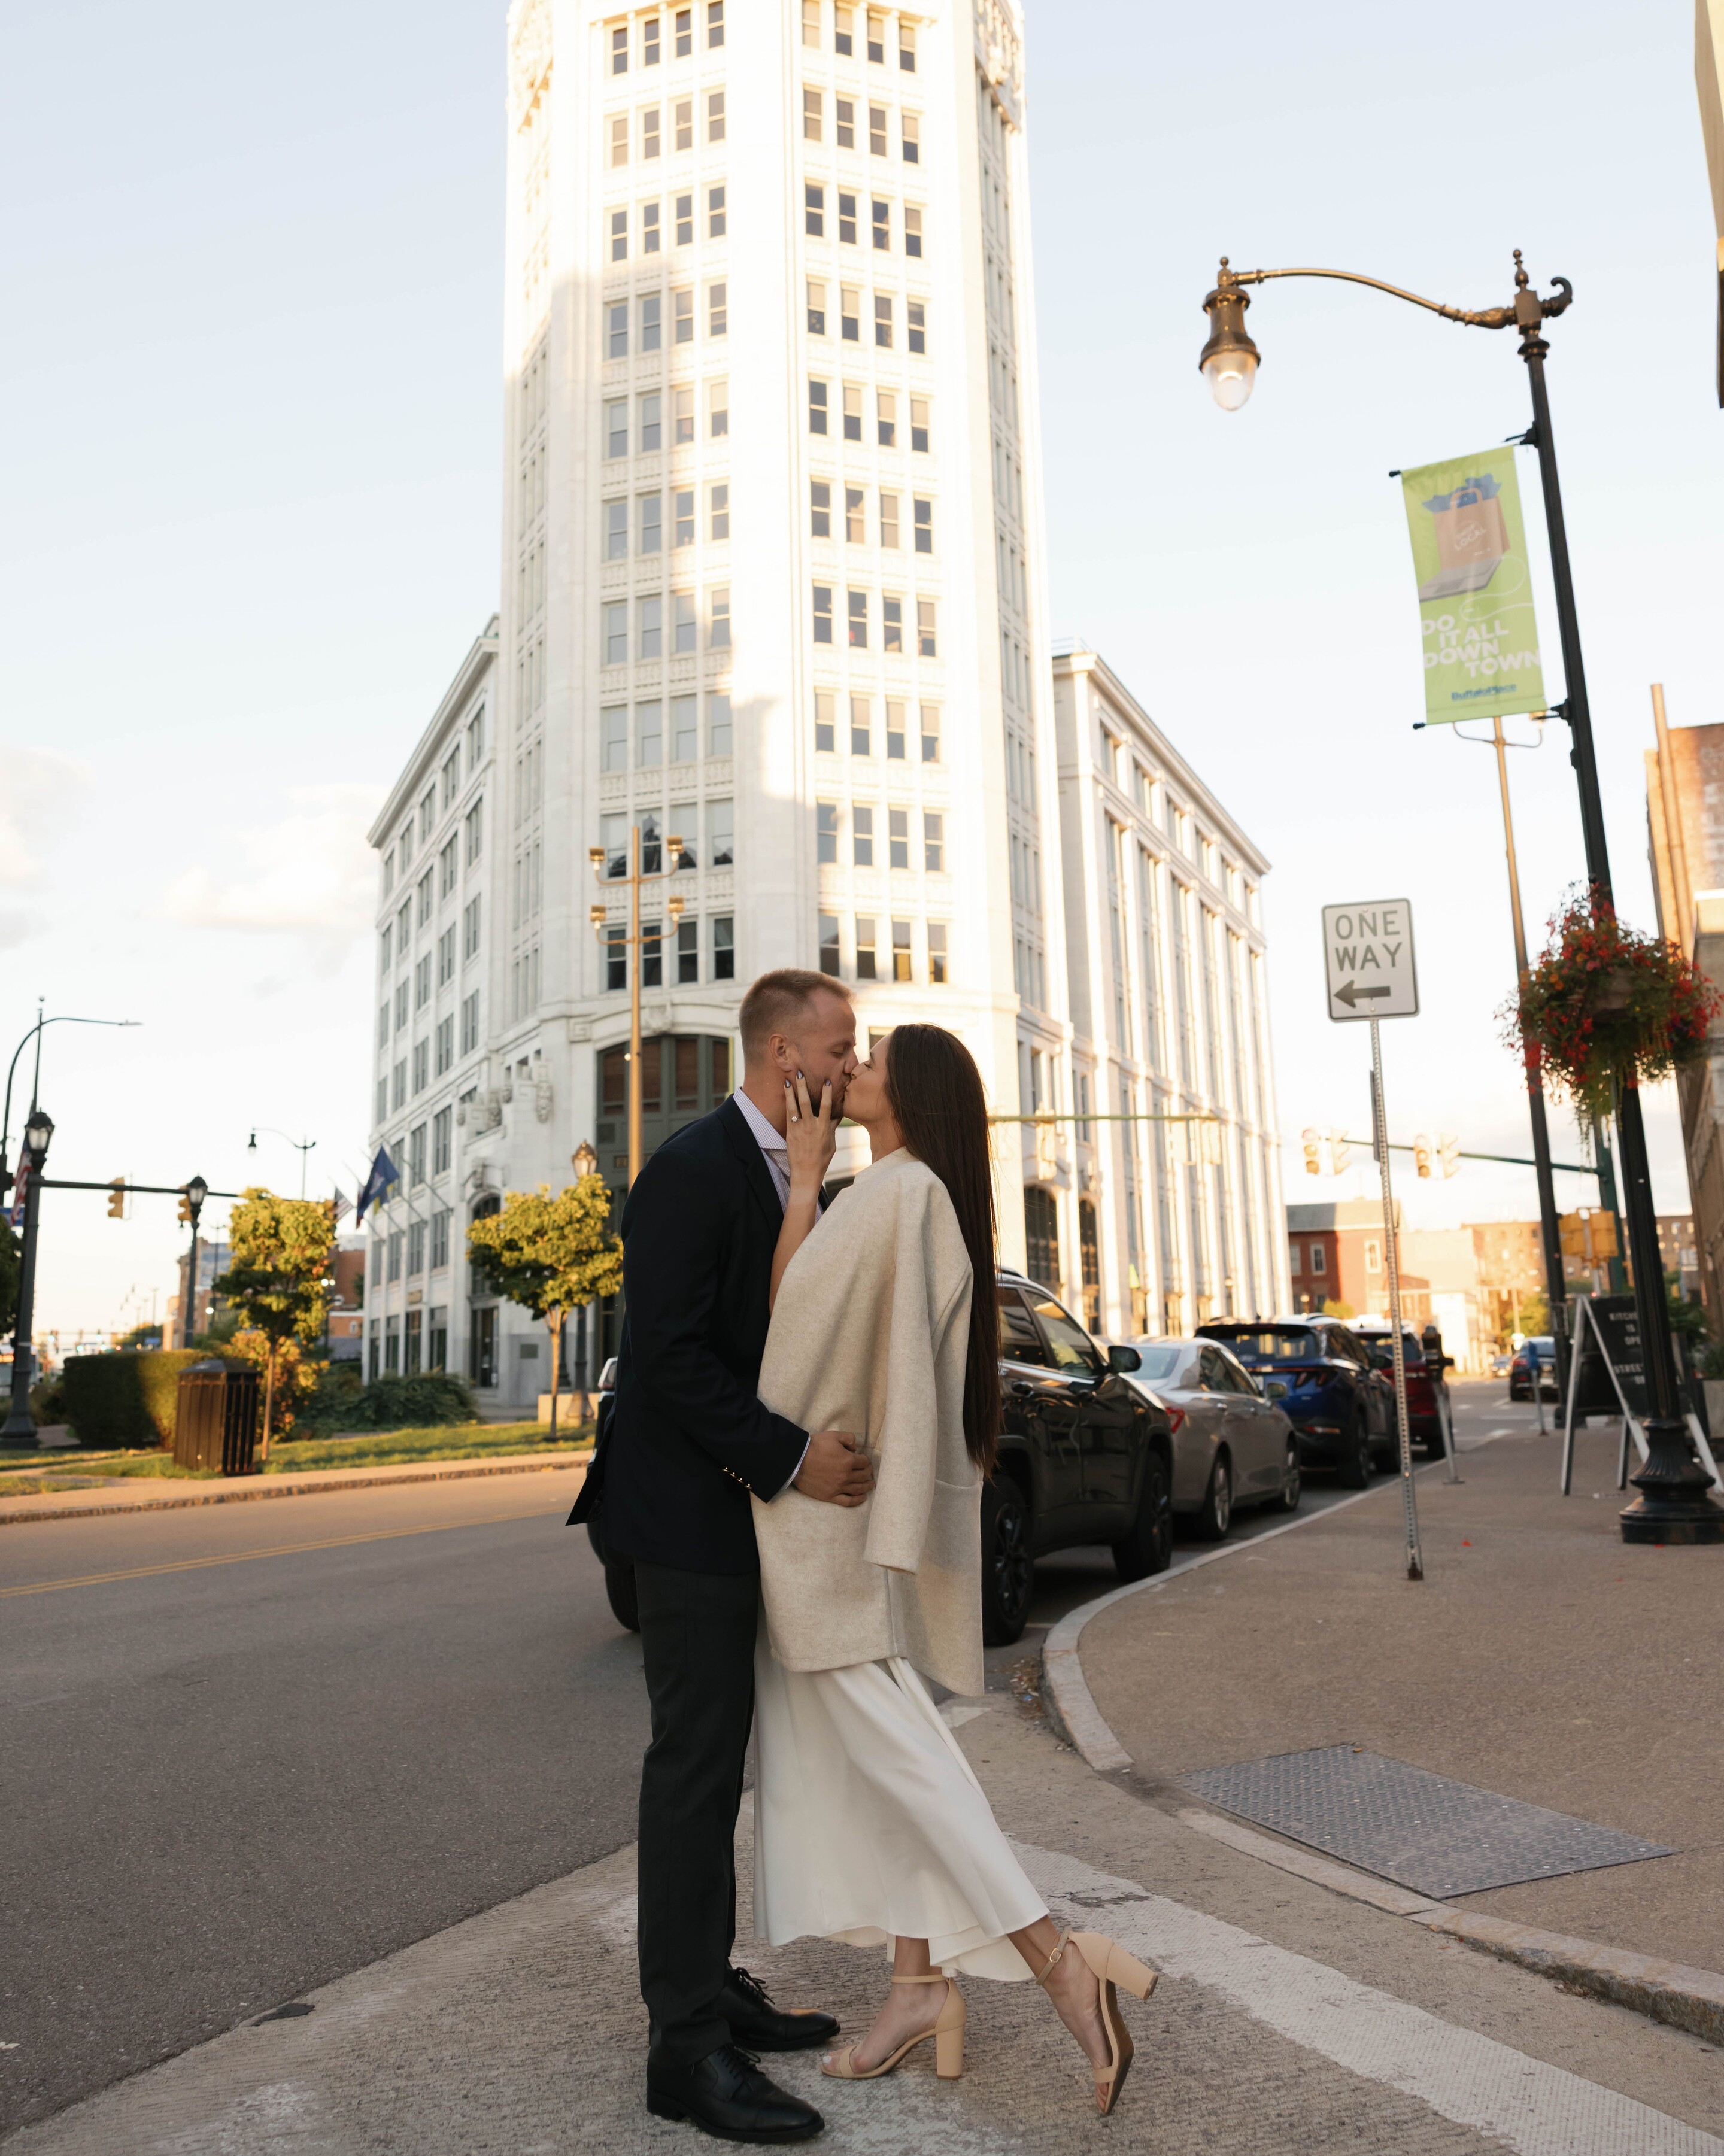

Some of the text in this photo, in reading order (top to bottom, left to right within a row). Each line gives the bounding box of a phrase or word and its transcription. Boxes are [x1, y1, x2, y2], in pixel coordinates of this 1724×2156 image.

[1422, 615, 1455, 636] DO
[1440, 620, 1509, 648] IT ALL
[1423, 638, 1500, 669] DOWN
[1465, 649, 1541, 678] TOWN
[1335, 910, 1400, 940] ONE
[1335, 942, 1403, 971] WAY
